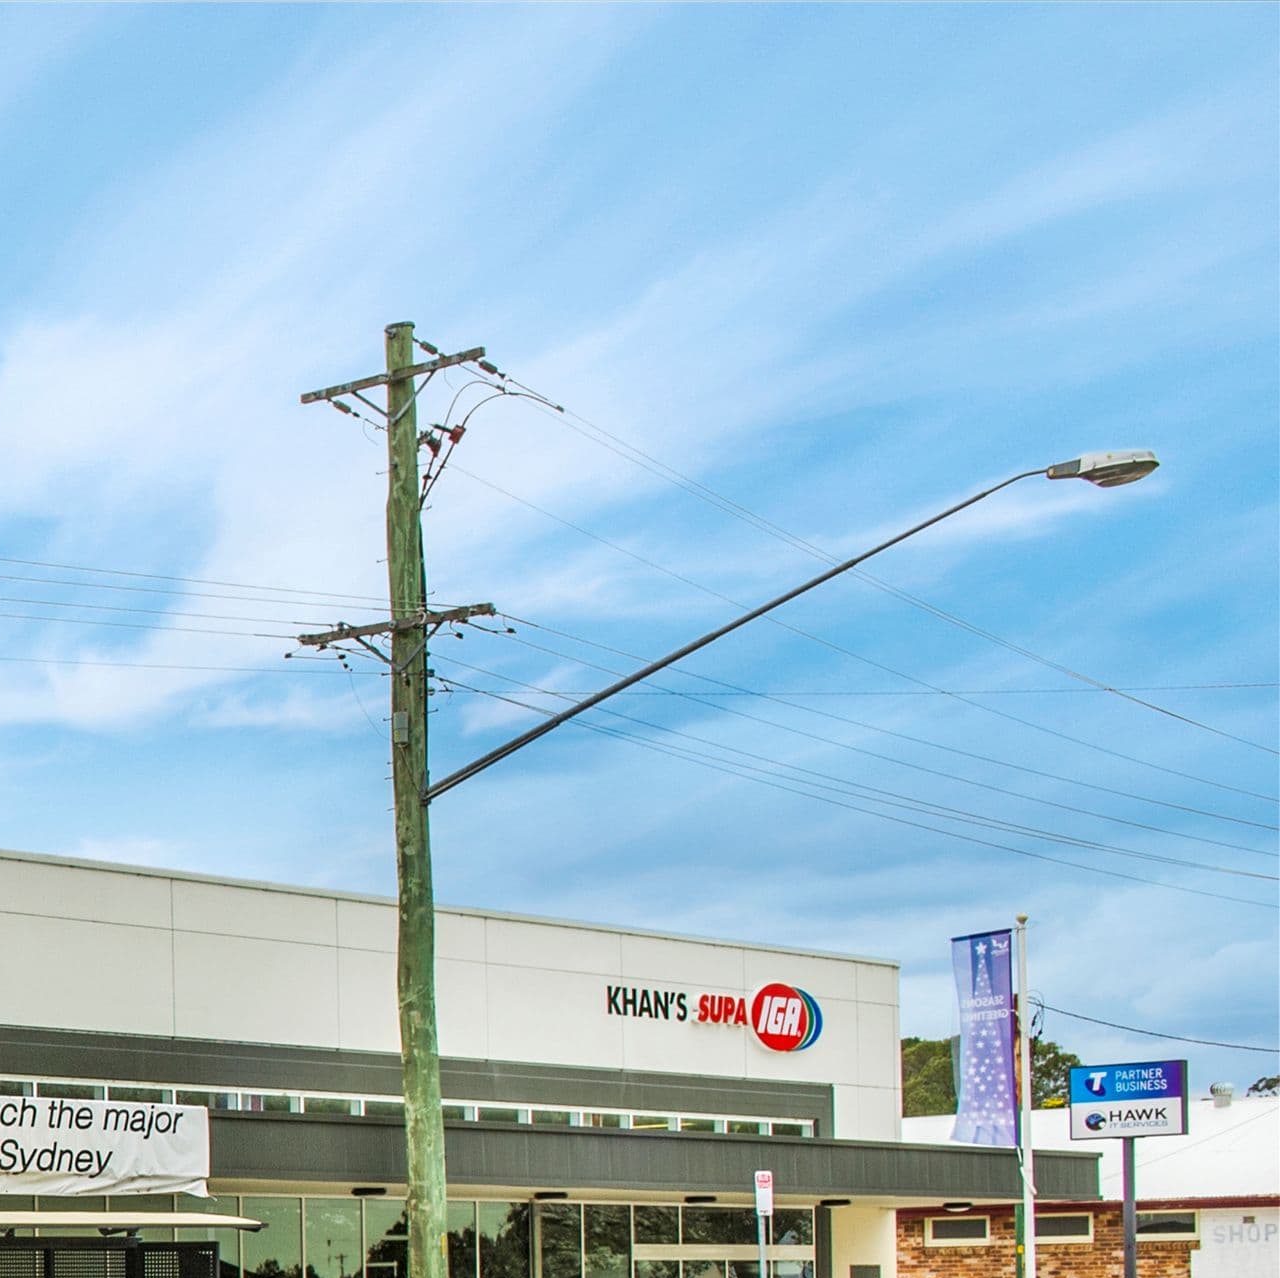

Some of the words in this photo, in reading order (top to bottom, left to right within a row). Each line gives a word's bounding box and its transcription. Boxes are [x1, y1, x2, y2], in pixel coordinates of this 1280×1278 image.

[607, 985, 688, 1022] KHAN'S
[697, 994, 748, 1026] SUPA
[757, 996, 801, 1037] IGA
[1115, 1068, 1162, 1079] PARTNER
[1116, 1079, 1167, 1092] BUSINESS
[48, 1099, 93, 1129] the
[103, 1104, 183, 1140] major
[1110, 1108, 1167, 1121] HAWK
[1121, 1120, 1168, 1128] SERVICES
[1214, 1224, 1277, 1243] SHOP
